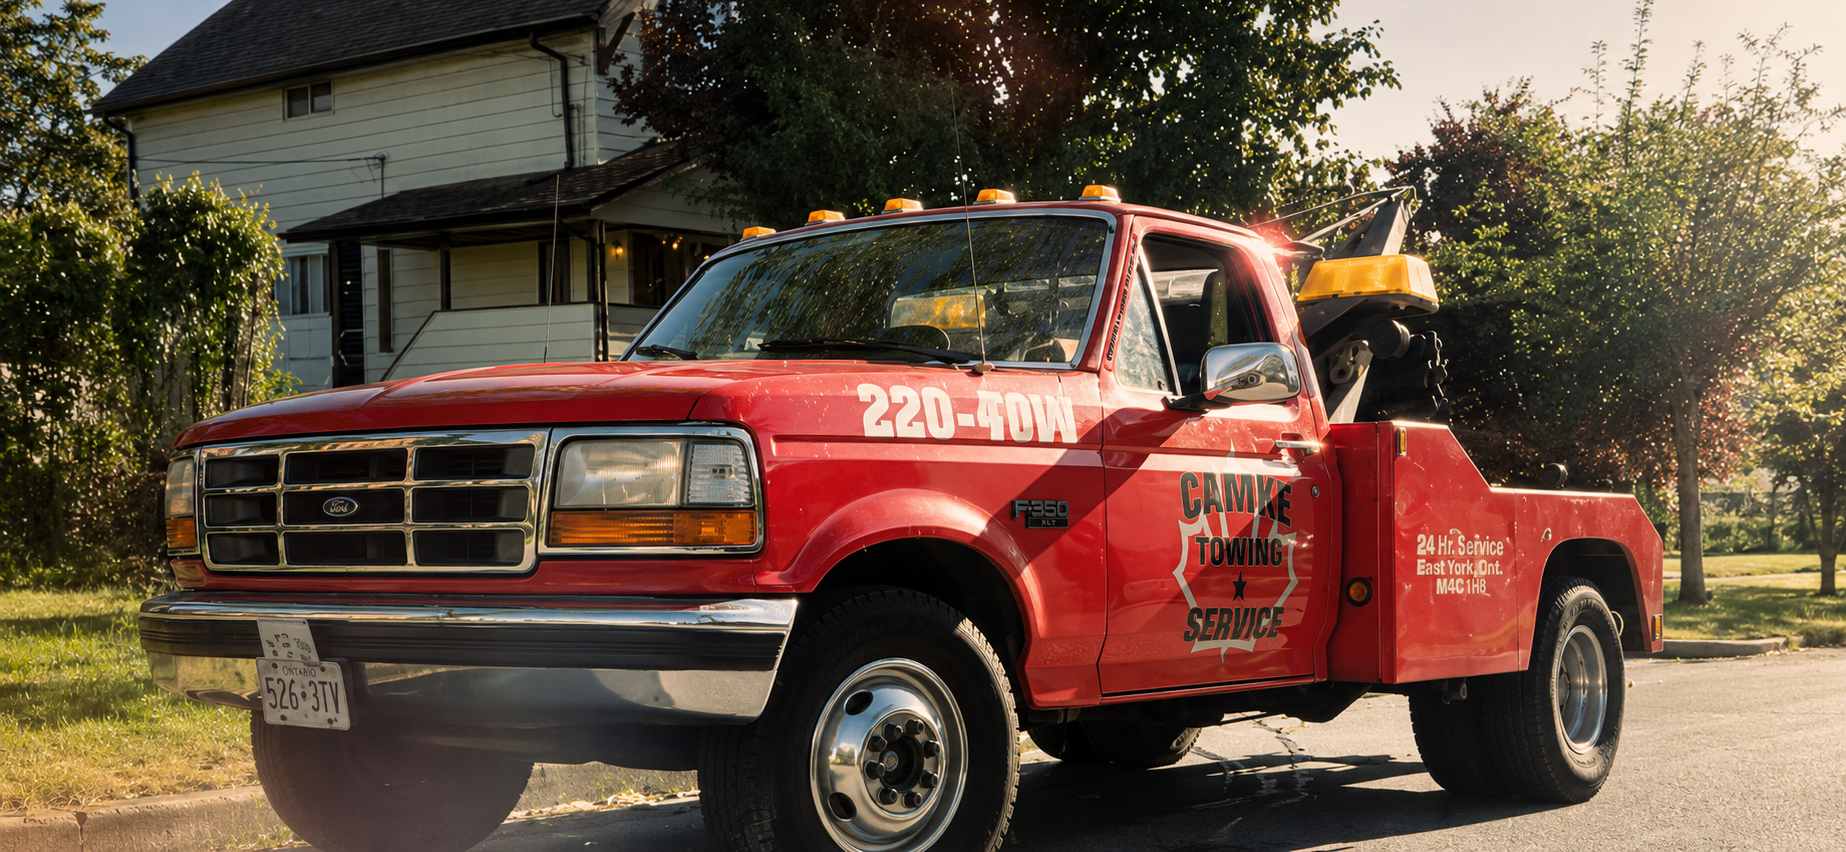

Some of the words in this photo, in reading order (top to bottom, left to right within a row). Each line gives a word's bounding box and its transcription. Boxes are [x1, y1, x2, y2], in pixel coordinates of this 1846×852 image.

[330, 500, 349, 513] Ford
[1180, 471, 1292, 528] CAMKE
[1195, 537, 1283, 568] TOWING
[1416, 533, 1436, 556] 24
[1437, 534, 1455, 556] Hr.
[1457, 534, 1504, 556] Service
[1416, 558, 1446, 576] East
[1478, 559, 1504, 576] Ont.
[1436, 578, 1465, 595] M4C
[1183, 606, 1285, 643] SERVICE
